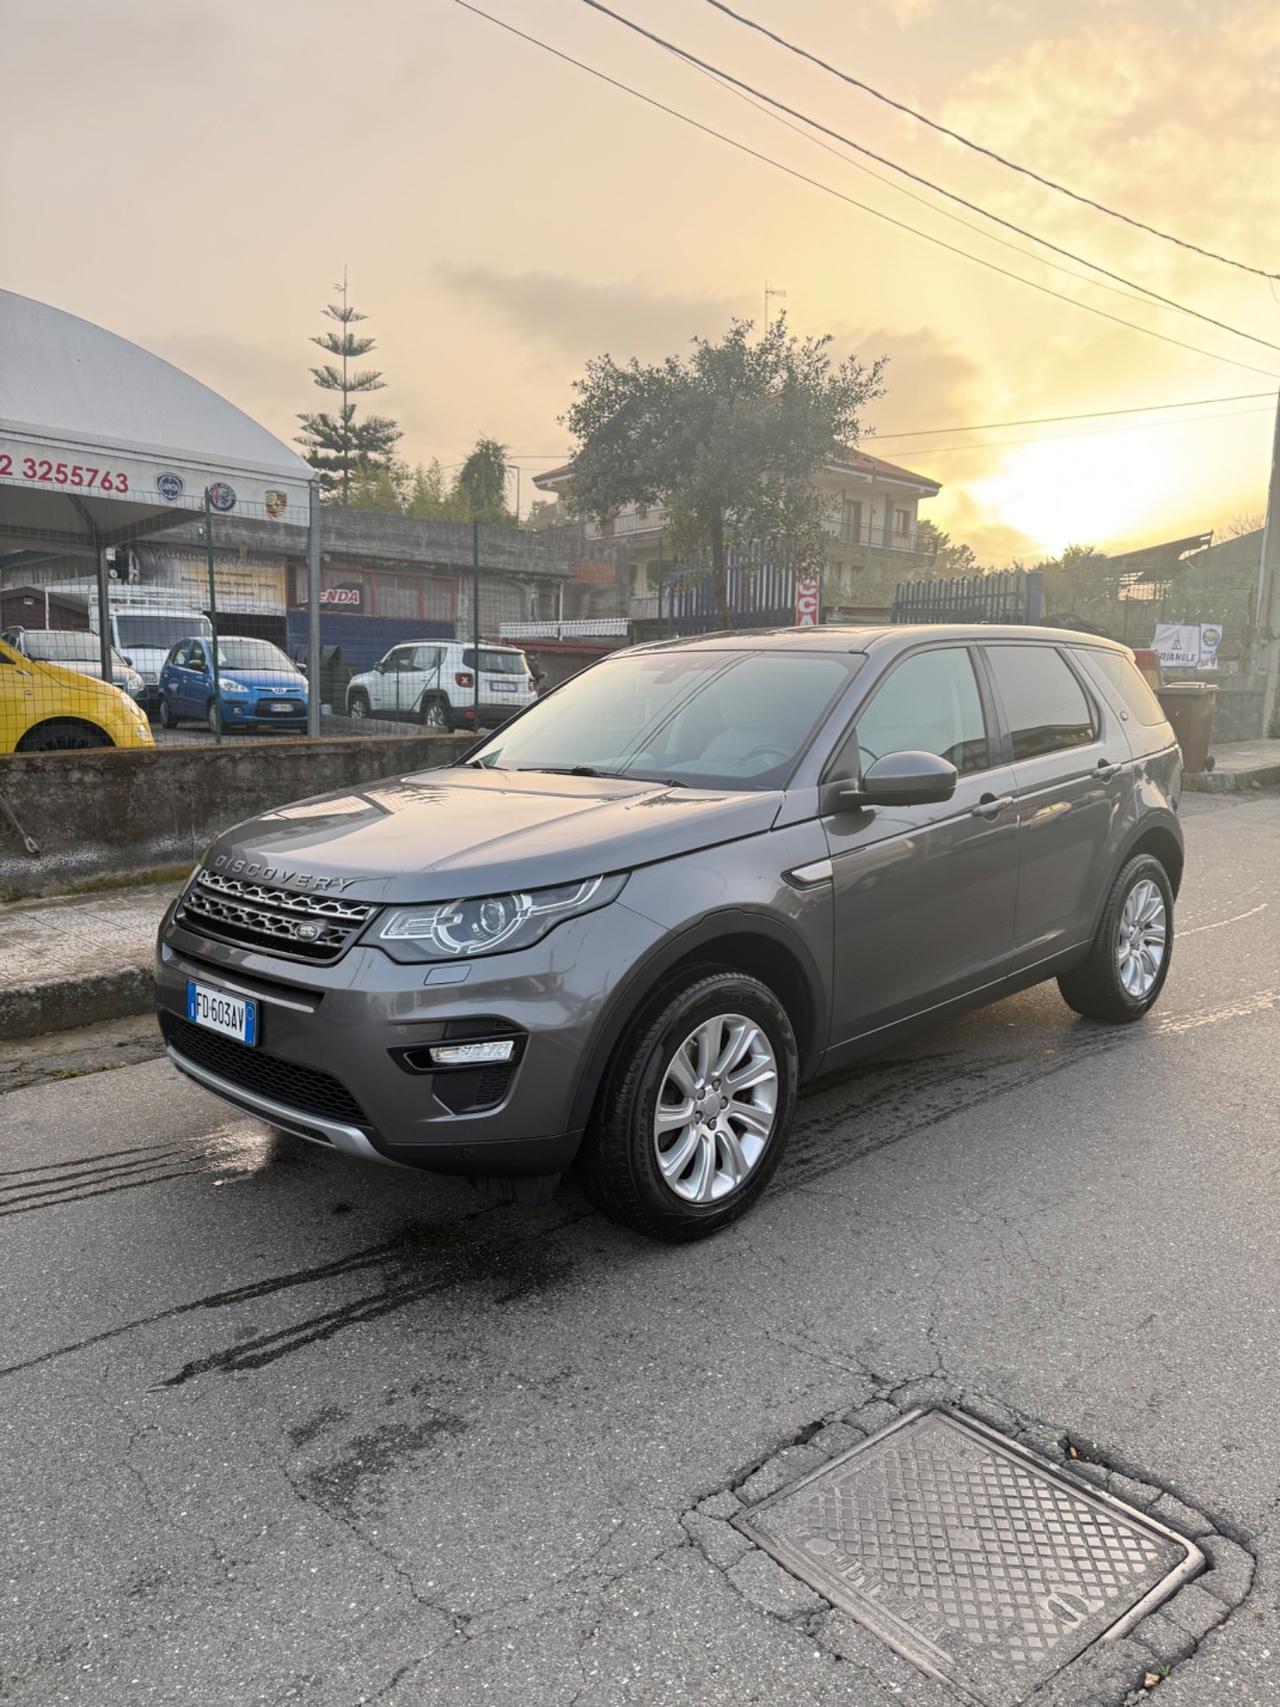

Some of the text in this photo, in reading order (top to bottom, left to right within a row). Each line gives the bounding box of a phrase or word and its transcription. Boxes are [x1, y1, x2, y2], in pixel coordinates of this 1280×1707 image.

[22, 457, 129, 493] 3255763
[1159, 652, 1197, 662] RIANGLE
[215, 854, 353, 894] DISCOVERY
